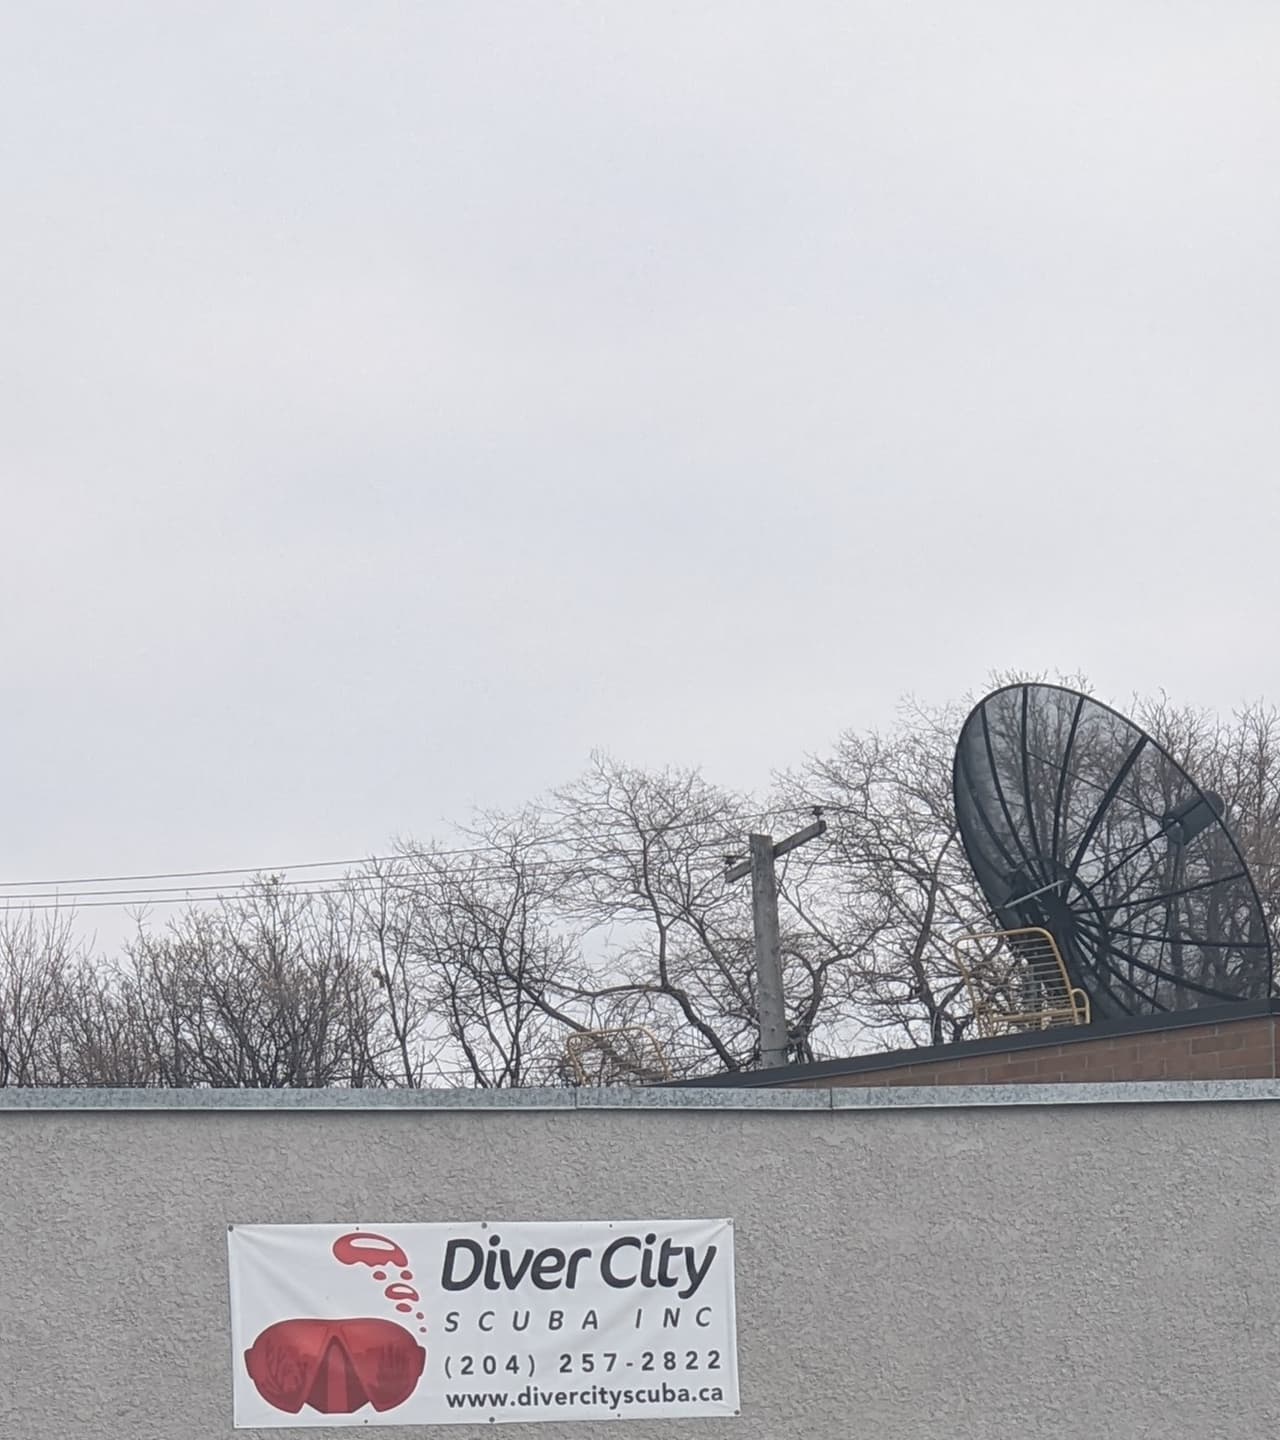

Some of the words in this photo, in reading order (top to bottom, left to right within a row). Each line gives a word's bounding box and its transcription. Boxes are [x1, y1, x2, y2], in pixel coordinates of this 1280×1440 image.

[441, 1234, 592, 1292] Diver
[600, 1233, 718, 1299] City
[444, 1310, 599, 1333] SCUBA
[634, 1307, 713, 1330] INC
[444, 1355, 537, 1377] (204)
[558, 1350, 722, 1375] 257-2822
[446, 1383, 724, 1409] www.divercityscuba.ca
